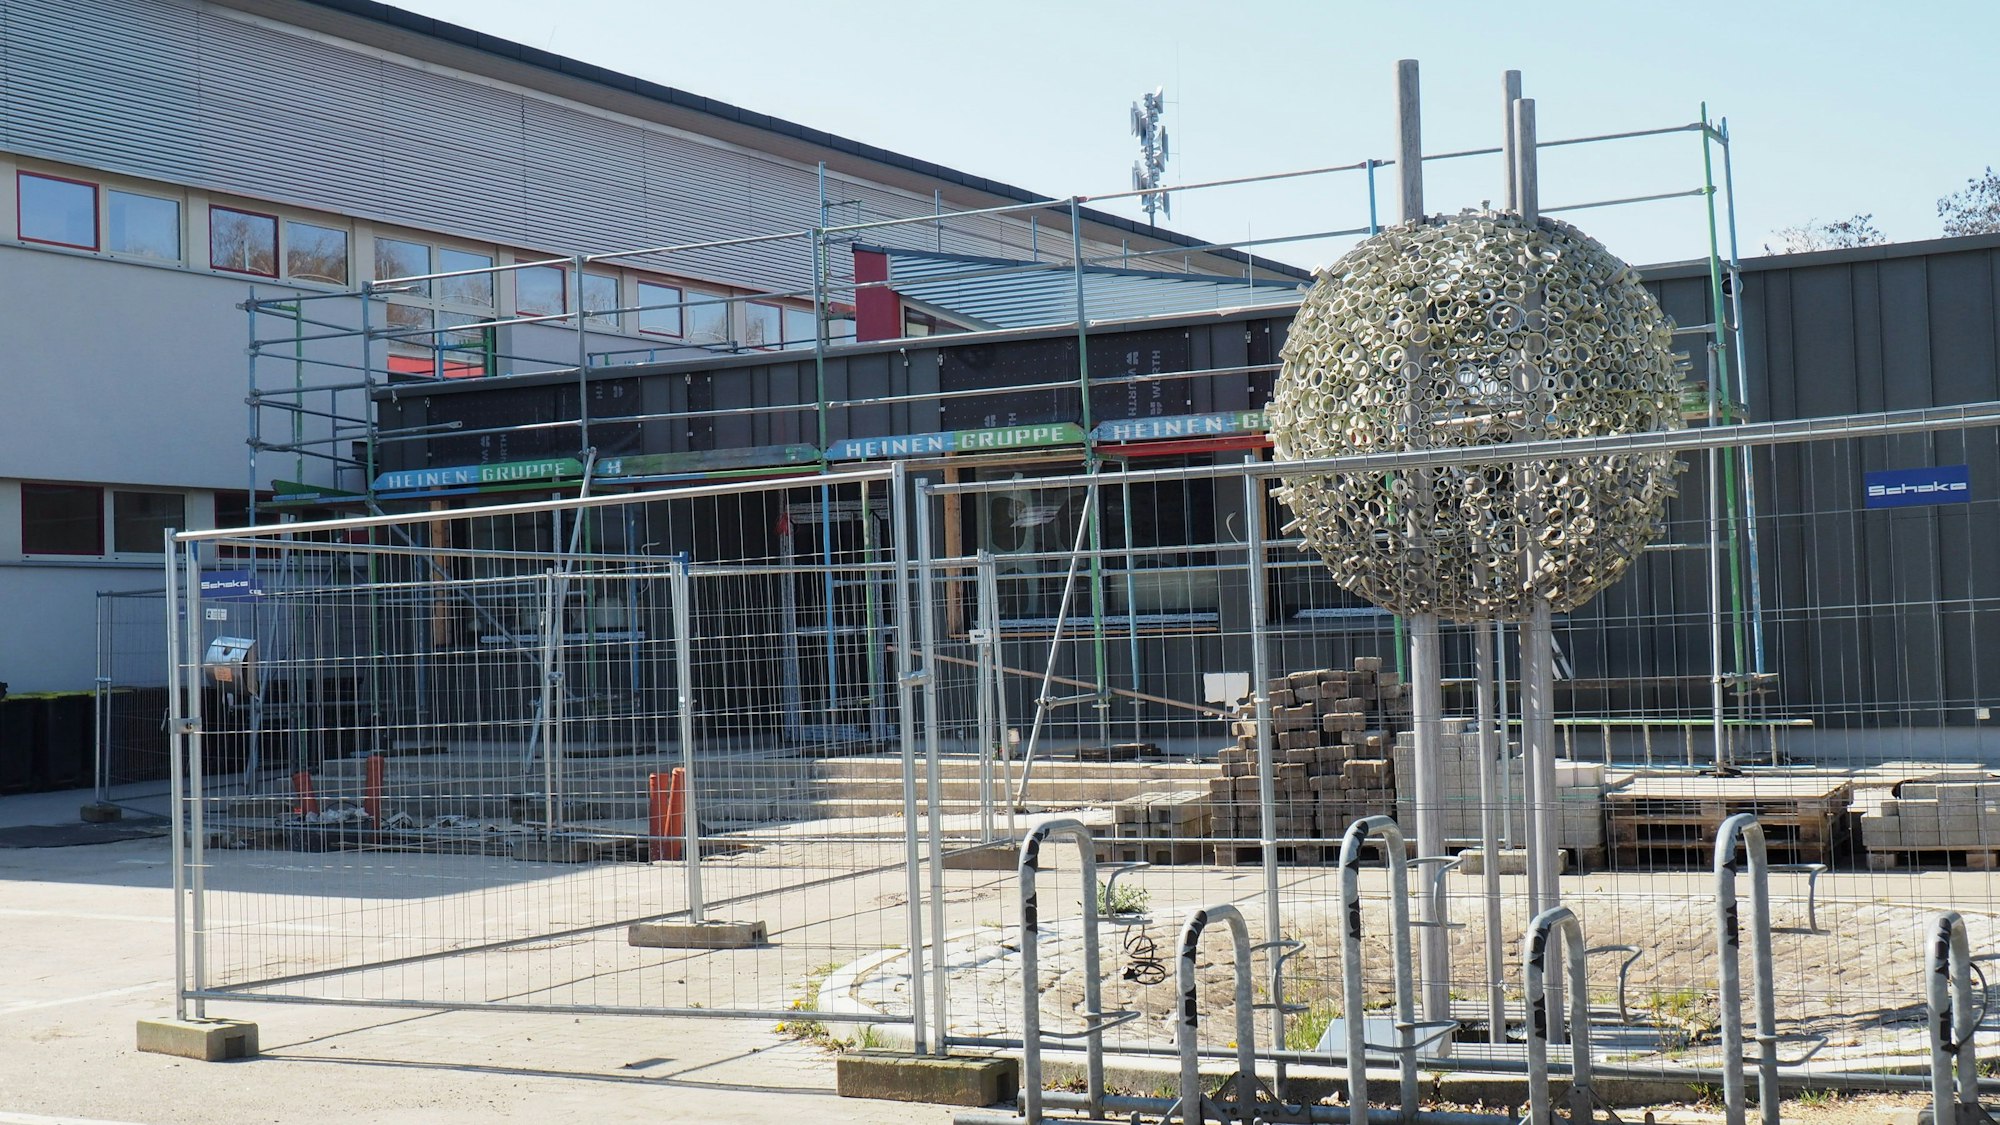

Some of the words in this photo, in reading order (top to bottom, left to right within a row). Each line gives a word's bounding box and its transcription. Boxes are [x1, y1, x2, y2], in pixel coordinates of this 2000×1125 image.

[846, 427, 1064, 457] HEINEN-GRUPPE
[389, 462, 567, 488] HEINEN-GRUPPE
[1868, 481, 1967, 497] Schake
[201, 579, 248, 590] Schake
